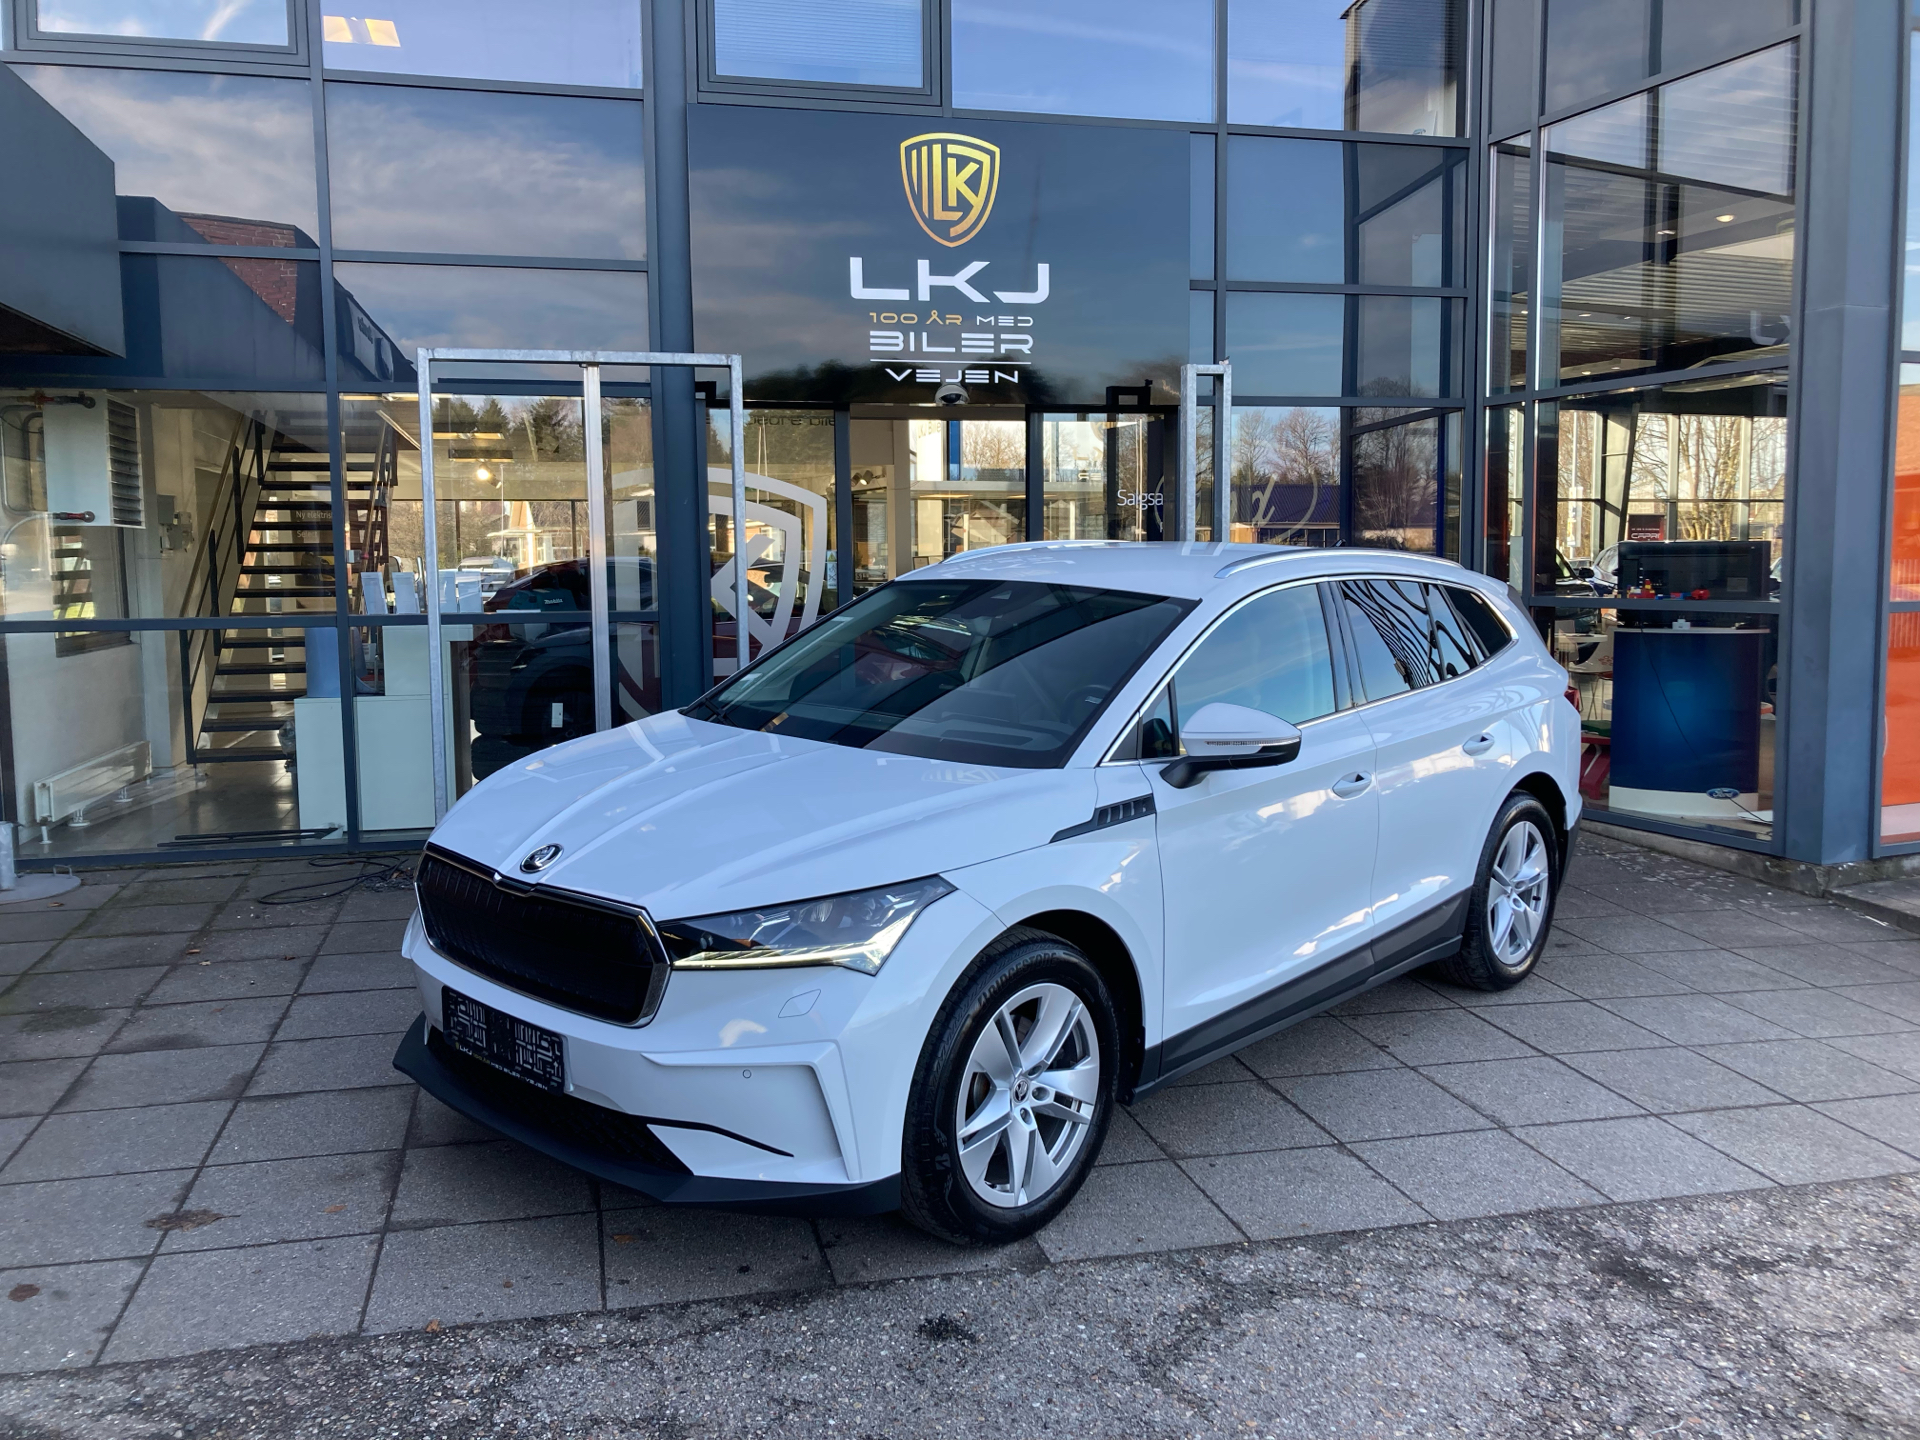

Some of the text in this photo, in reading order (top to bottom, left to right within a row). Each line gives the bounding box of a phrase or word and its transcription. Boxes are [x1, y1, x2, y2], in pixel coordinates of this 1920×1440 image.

[850, 257, 1050, 304] LKJ
[869, 309, 1034, 327] 100 ÅR MED
[869, 330, 1034, 354] BILER
[885, 368, 1019, 384] VEJEN
